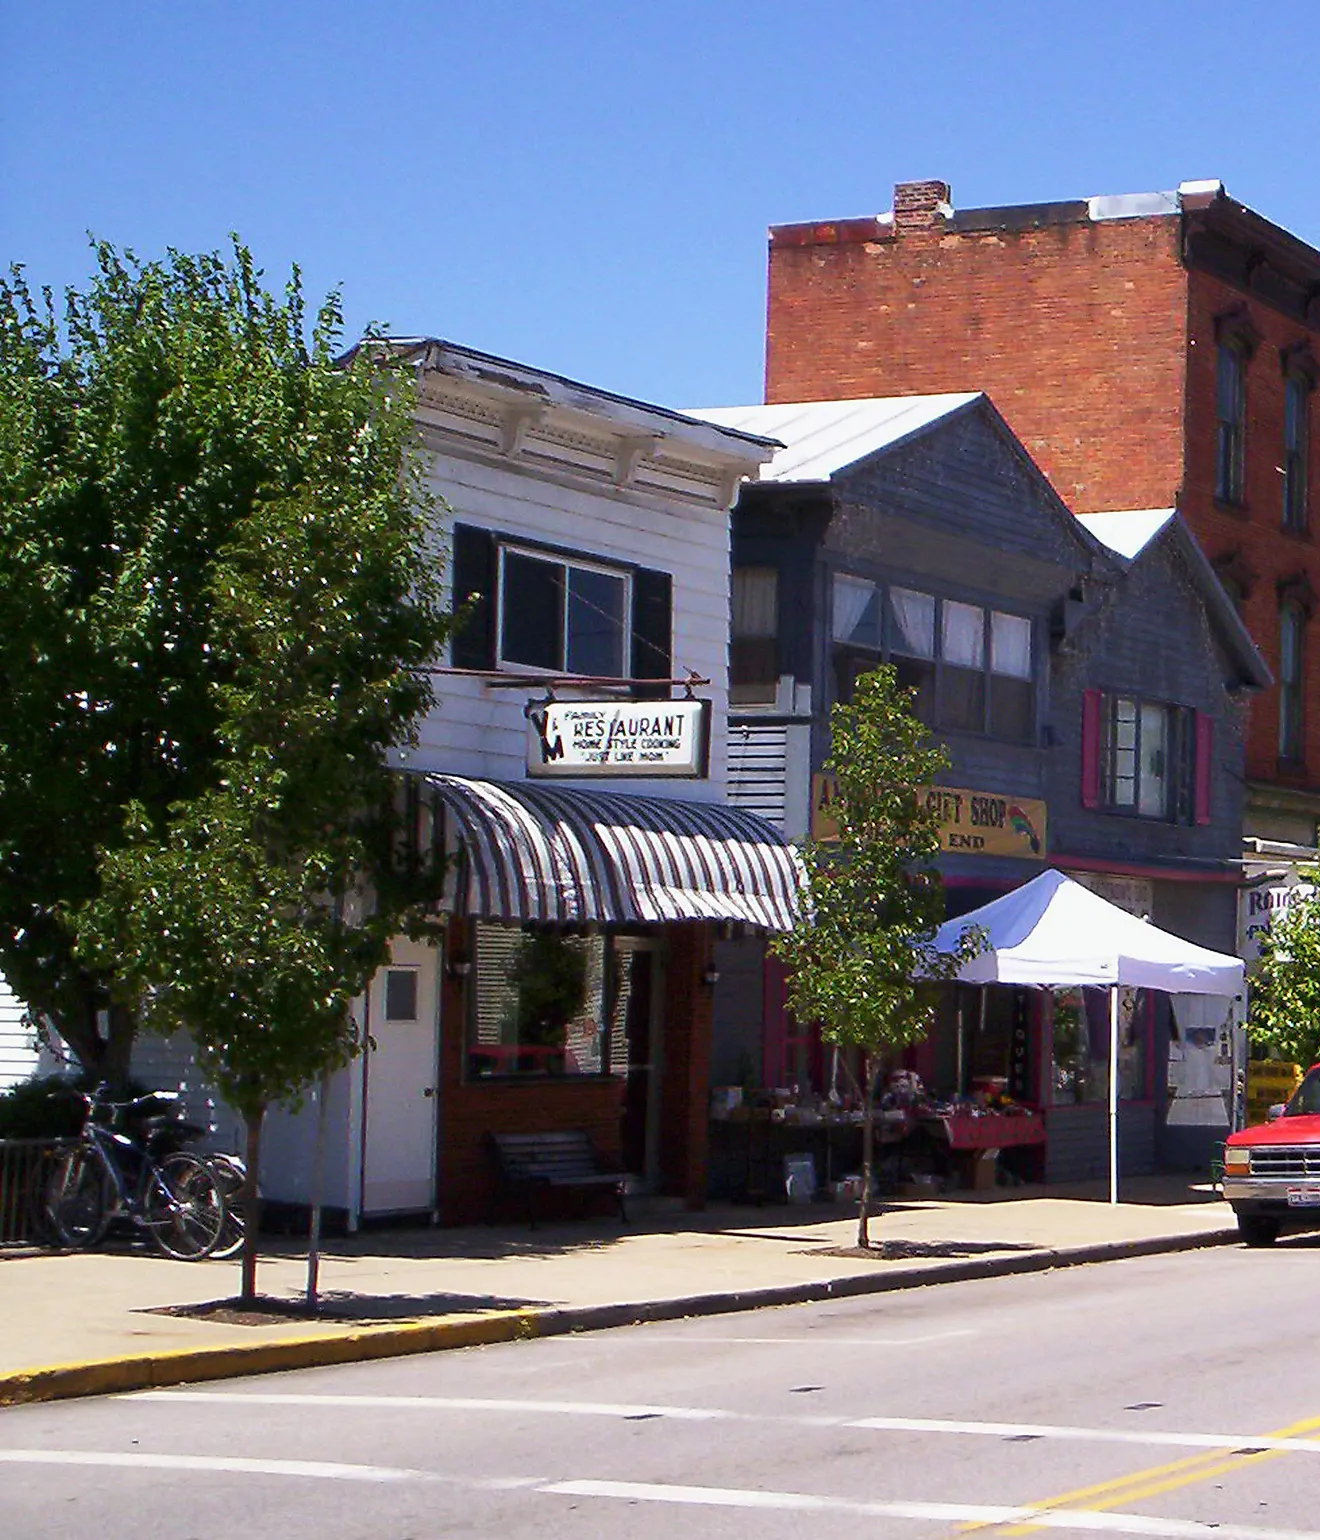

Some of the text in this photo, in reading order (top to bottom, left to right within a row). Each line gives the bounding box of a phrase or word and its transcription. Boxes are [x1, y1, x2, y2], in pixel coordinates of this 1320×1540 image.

[564, 710, 605, 720] FAMILY
[572, 738, 681, 749] HOME STYLE COOKING
[970, 795, 1006, 829] SHOP
[948, 832, 986, 849] END
